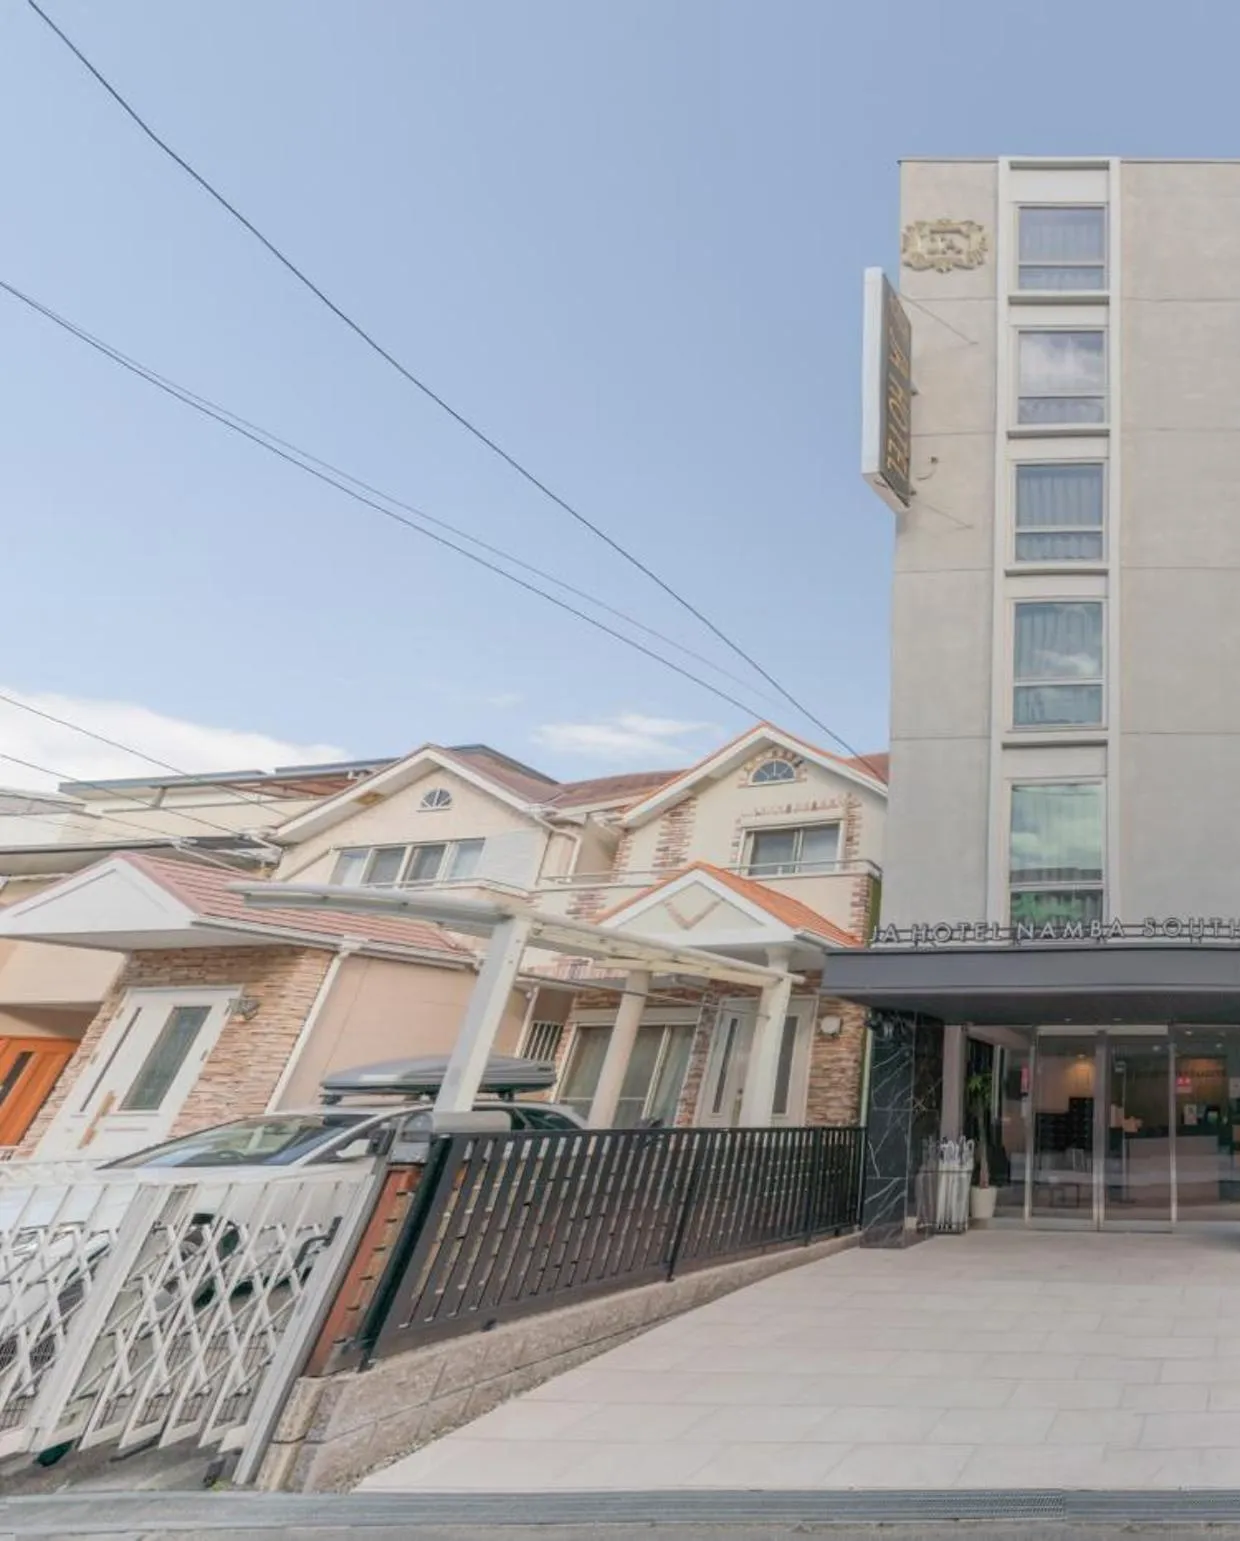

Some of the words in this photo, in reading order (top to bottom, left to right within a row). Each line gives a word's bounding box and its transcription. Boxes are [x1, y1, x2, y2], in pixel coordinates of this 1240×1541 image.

[887, 372, 909, 480] HOTEL
[870, 923, 900, 942] JA
[911, 921, 1001, 942] HOTEL
[1016, 917, 1125, 940] NAMBA
